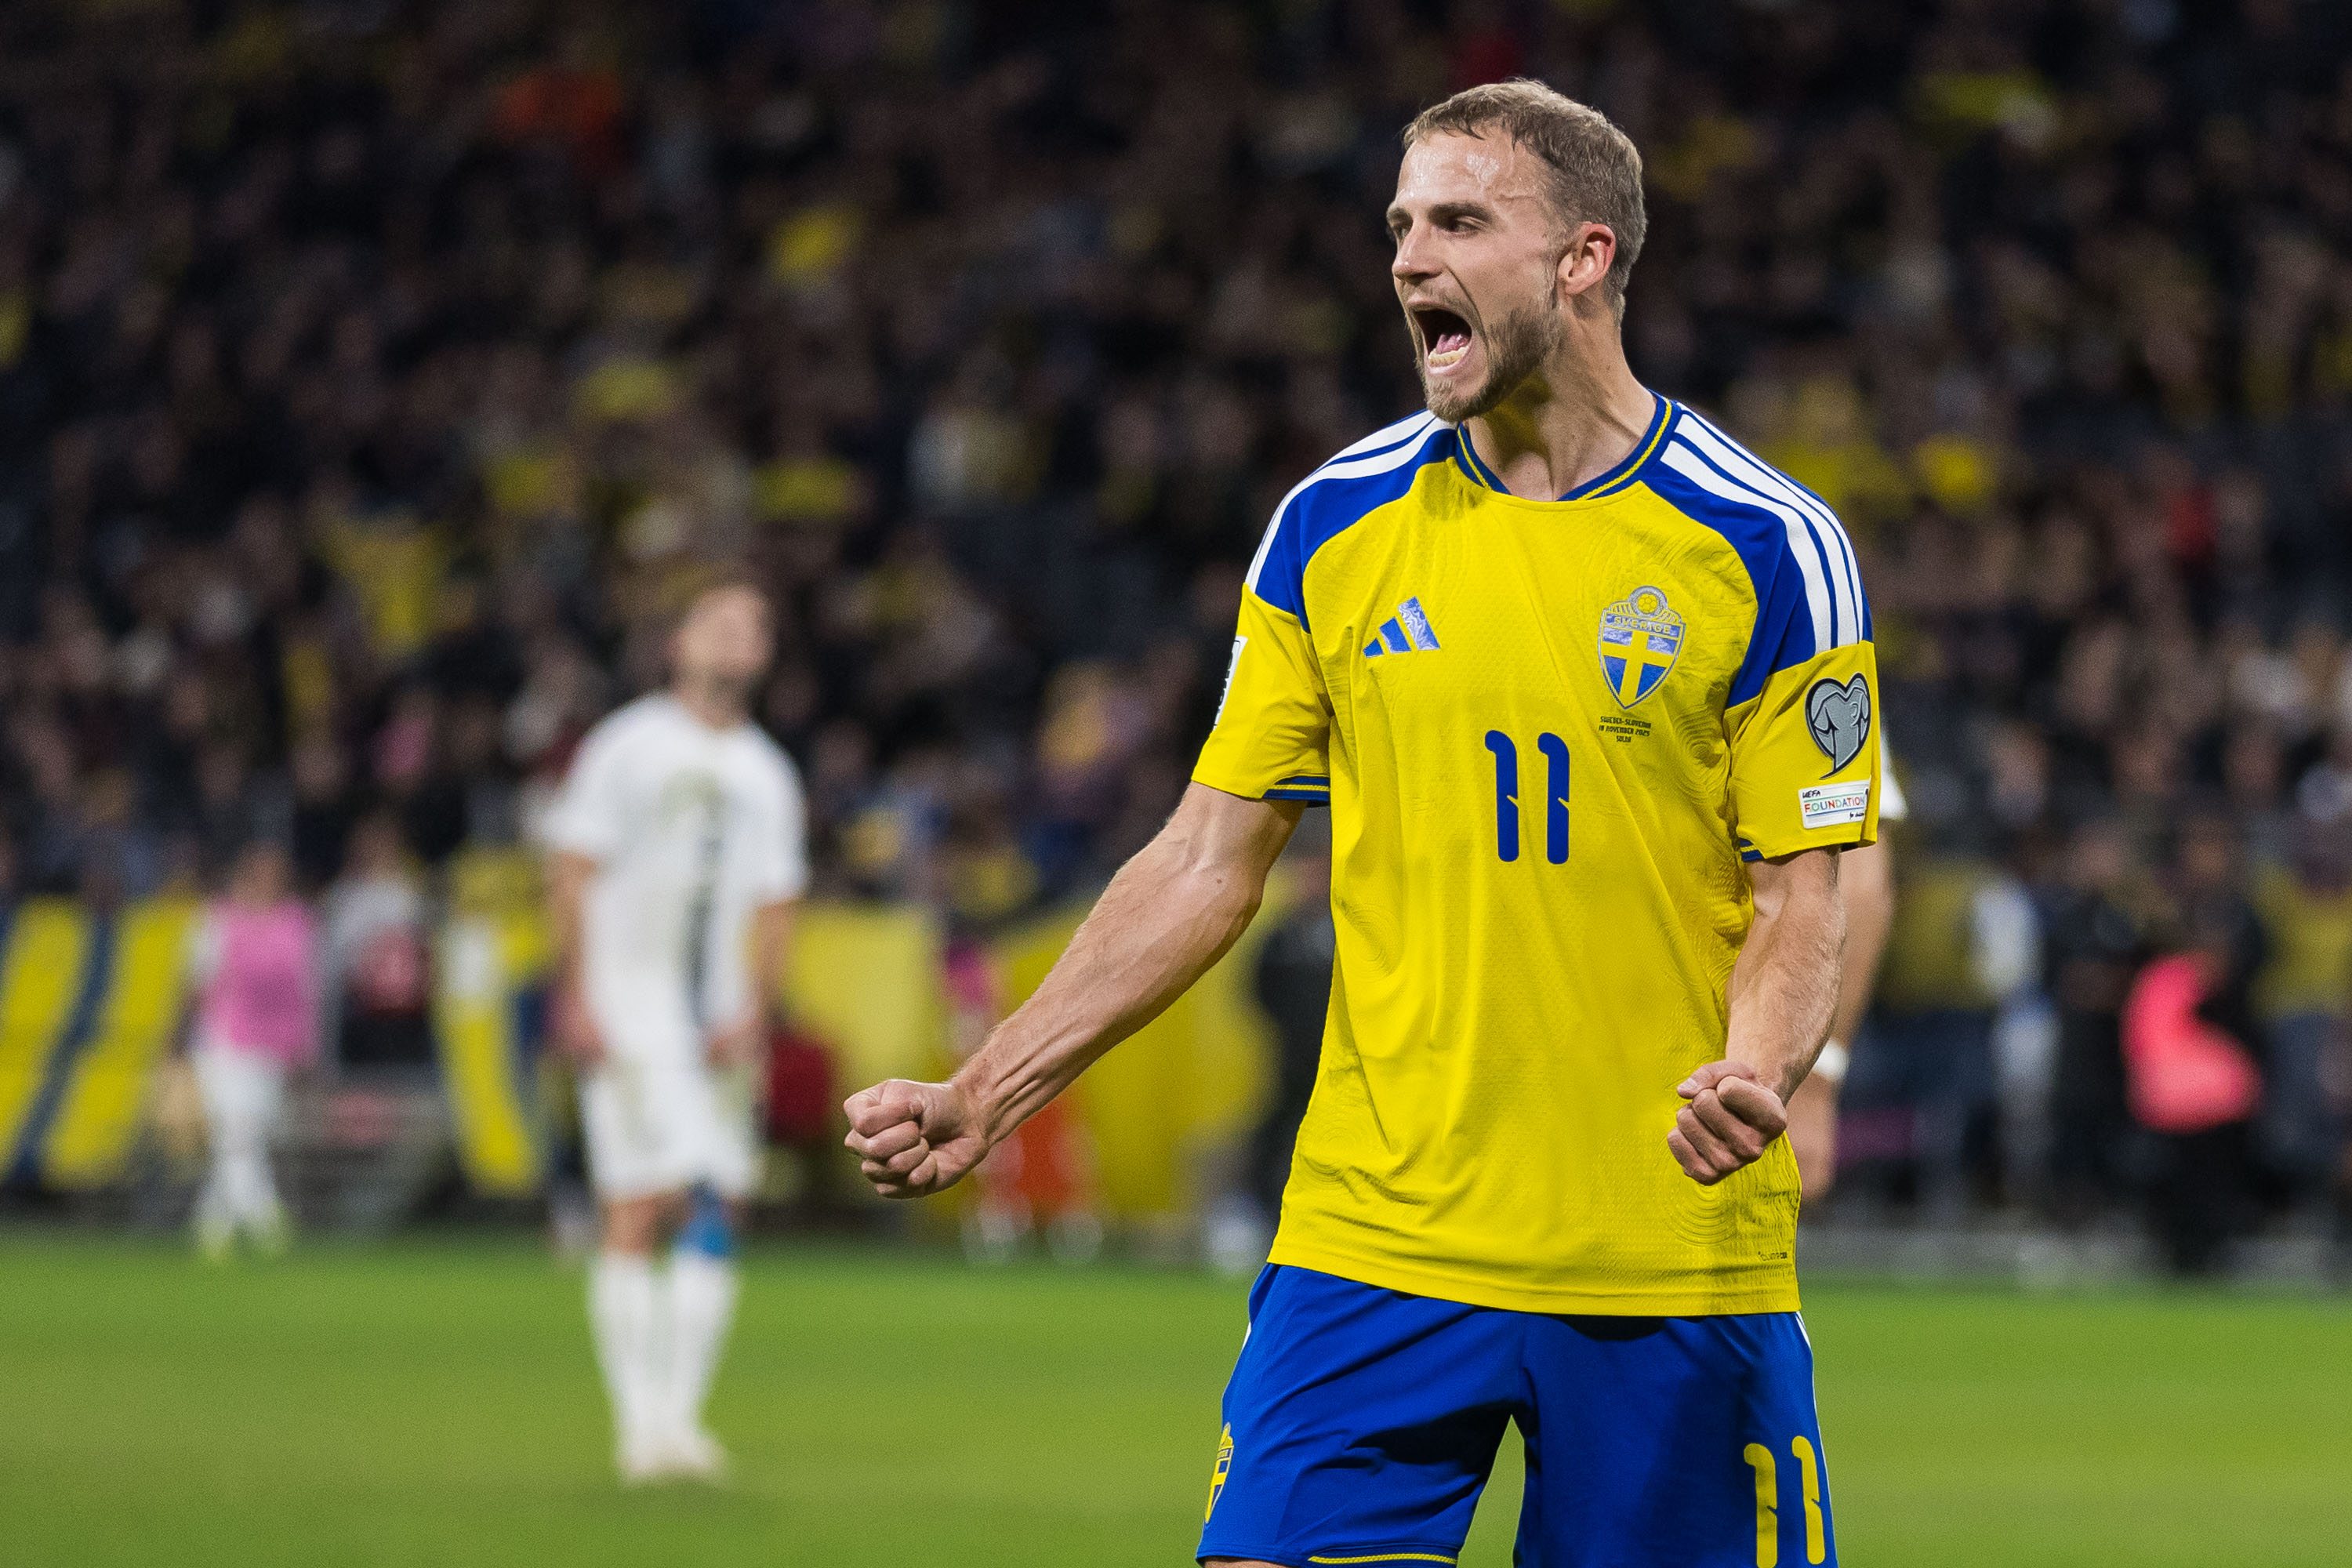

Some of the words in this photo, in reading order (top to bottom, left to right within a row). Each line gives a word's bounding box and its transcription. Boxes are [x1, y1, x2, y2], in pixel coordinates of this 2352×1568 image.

[1613, 616, 1671, 633] SVERIGE
[1606, 726, 1635, 735] NOVEMBER
[1484, 729, 1570, 866] 11
[1802, 789, 1821, 799] UEFA
[1804, 796, 1865, 813] FOUNDATION
[1743, 1436, 1826, 1568] 11
